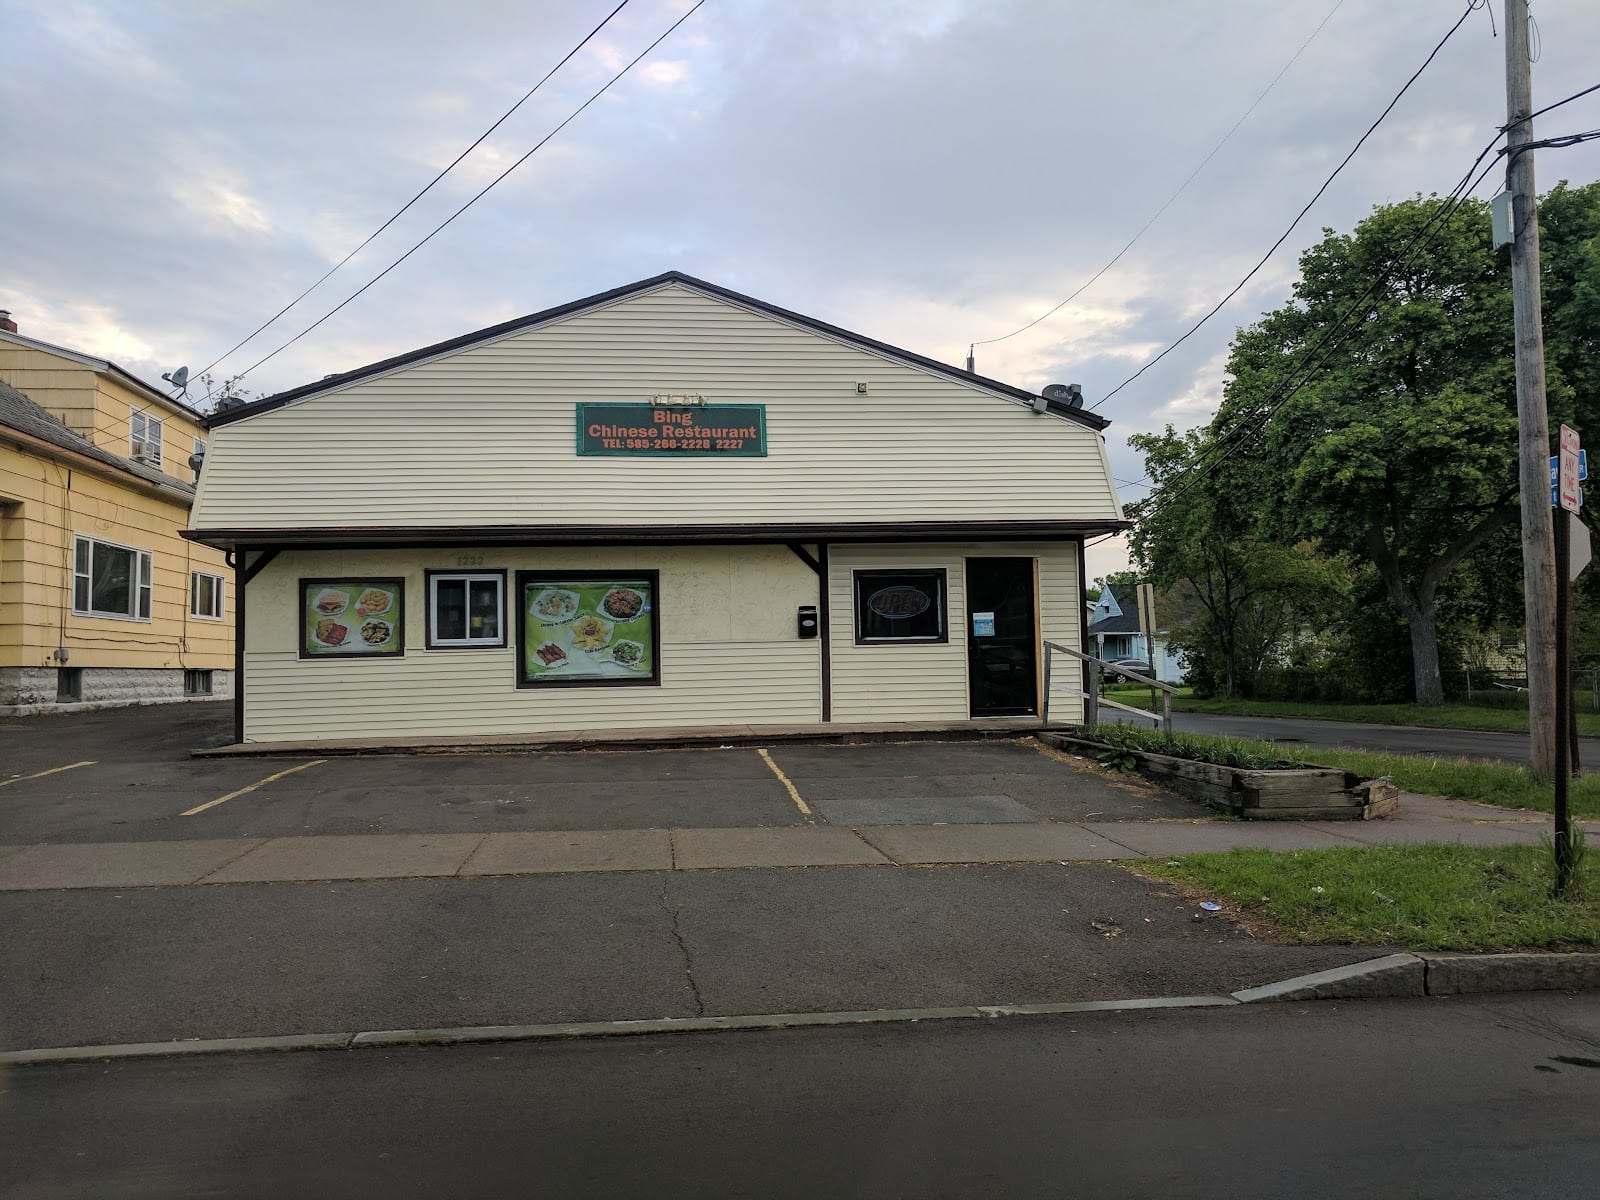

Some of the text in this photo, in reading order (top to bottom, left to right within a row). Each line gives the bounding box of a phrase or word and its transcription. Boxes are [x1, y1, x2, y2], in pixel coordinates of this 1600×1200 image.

[654, 410, 693, 426] Bing
[588, 424, 756, 438] Chinese Restaurant
[603, 439, 625, 449] TEL:
[716, 439, 744, 449] 2227
[1565, 456, 1574, 473] ANY
[1564, 473, 1575, 492] TIME
